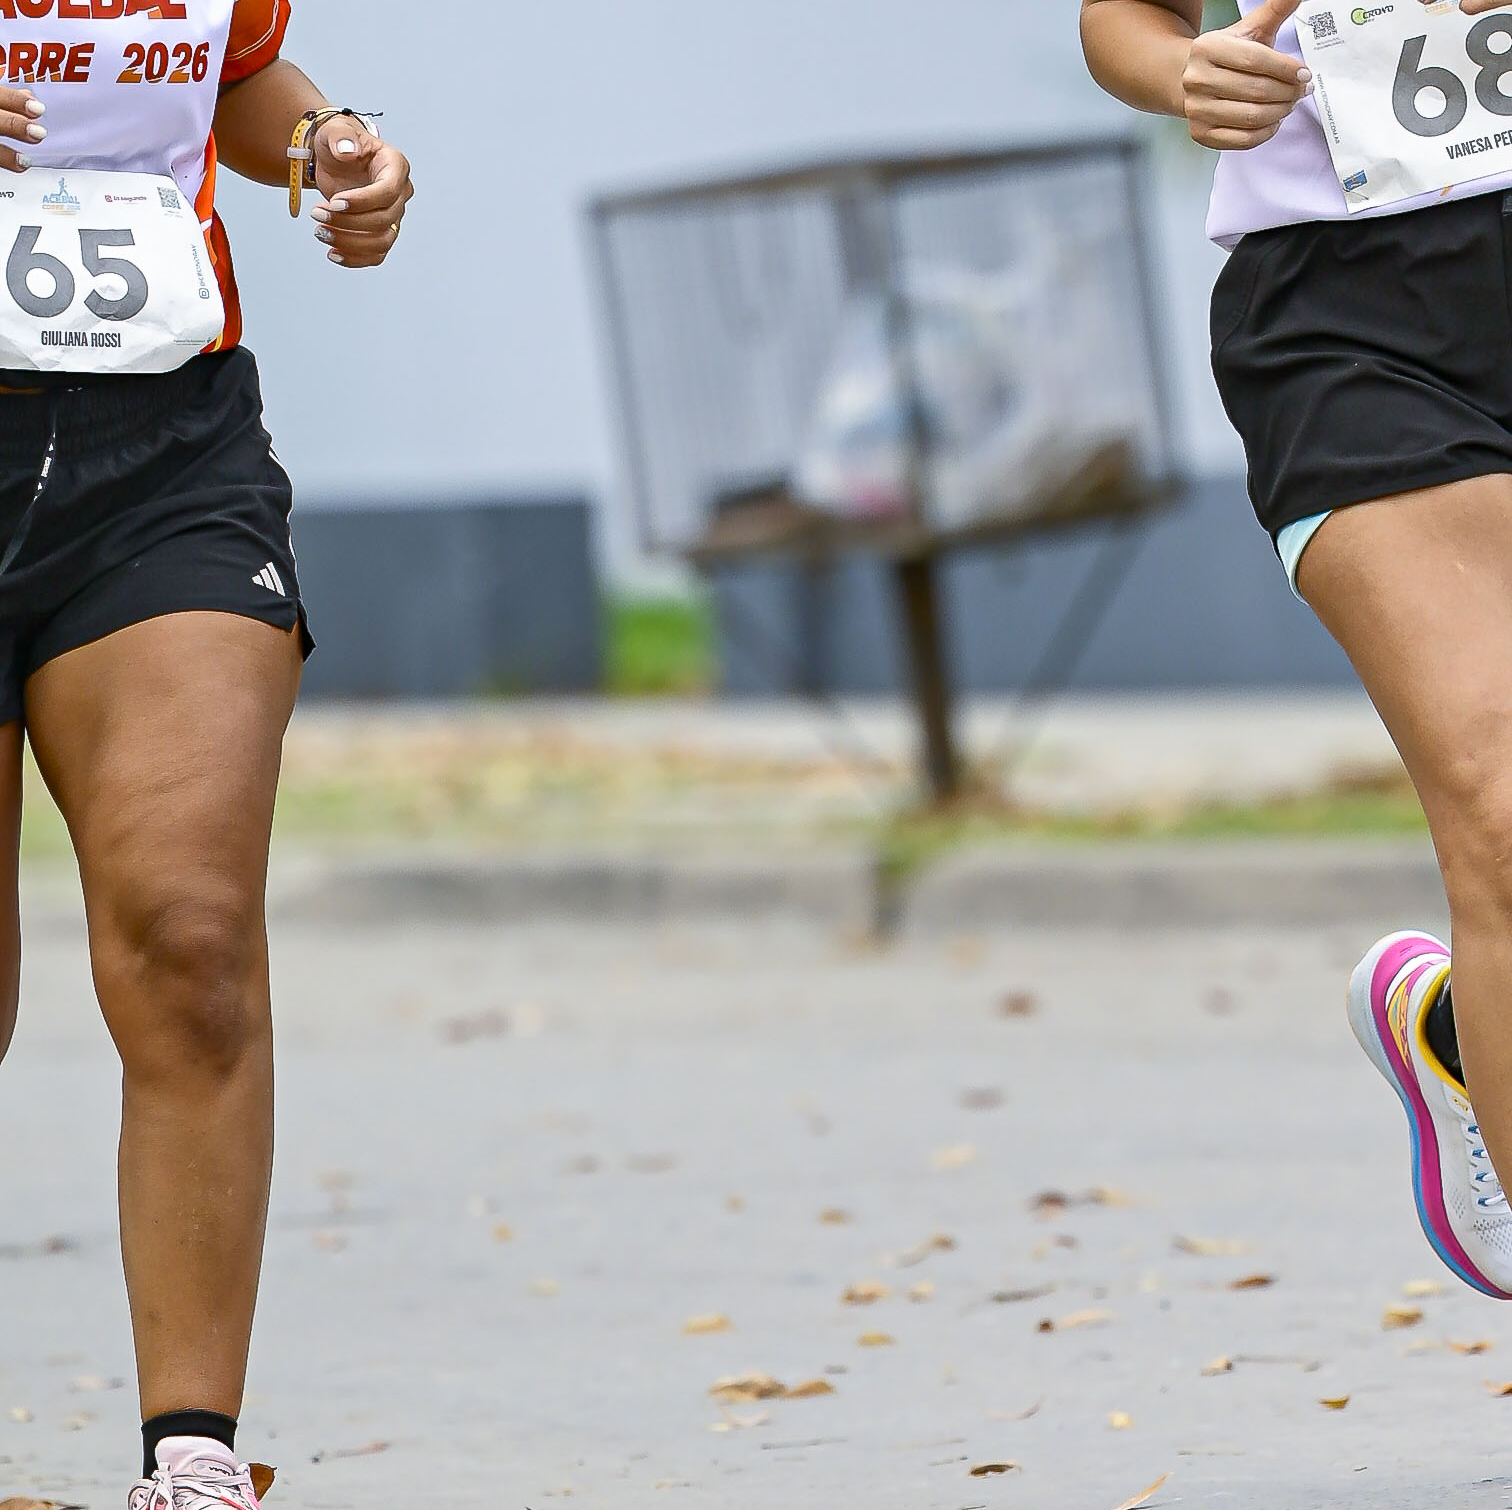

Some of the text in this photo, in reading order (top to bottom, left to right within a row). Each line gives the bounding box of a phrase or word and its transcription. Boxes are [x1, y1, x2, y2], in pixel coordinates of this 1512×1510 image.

[0, 42, 210, 84] RRE 2026
[1446, 136, 1493, 160] VANESA
[6, 225, 149, 321] 65
[41, 330, 122, 348] GIULIANA ROSSI
